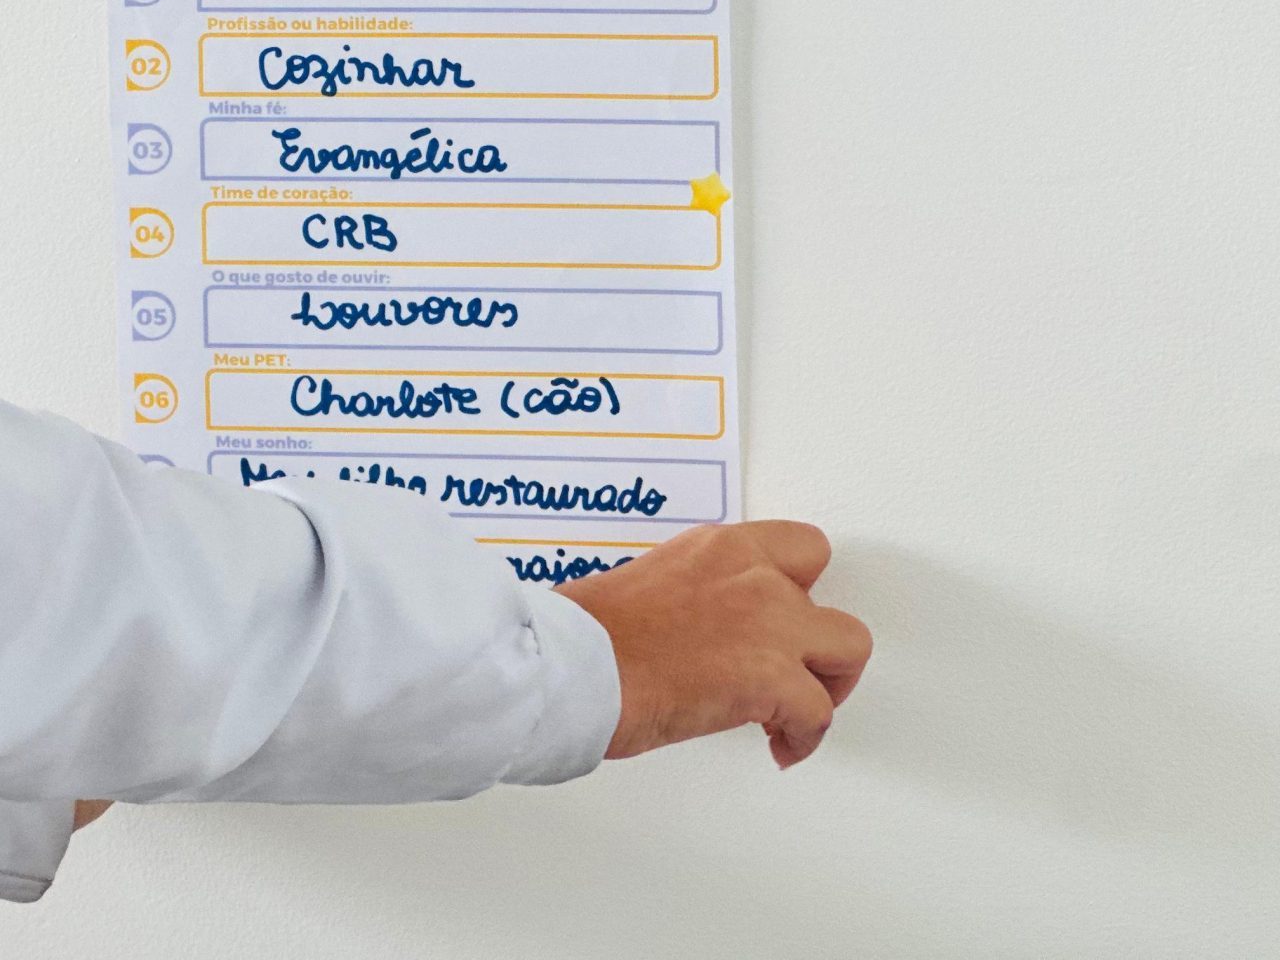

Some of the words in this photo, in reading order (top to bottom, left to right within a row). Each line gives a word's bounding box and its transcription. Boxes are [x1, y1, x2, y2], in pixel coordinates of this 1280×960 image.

[207, 17, 287, 30] Profissão
[291, 19, 313, 30] ou
[317, 17, 413, 30] habilidade:
[131, 57, 161, 75] 02
[259, 44, 475, 97] Cozinhar
[209, 102, 262, 114] Minha
[267, 101, 287, 115] fé:
[133, 141, 163, 159] 03
[271, 127, 508, 179] Evangélica
[210, 186, 253, 199] Time
[258, 186, 278, 199] de
[281, 186, 353, 203] coração:
[135, 225, 165, 243] 04
[302, 213, 397, 252] CRB
[212, 270, 224, 282] O
[229, 273, 260, 286] que
[265, 273, 313, 286] gosto
[317, 270, 337, 283] de
[342, 272, 391, 284] ouvir:
[136, 308, 167, 326] 05
[291, 291, 518, 330] Louvores
[214, 353, 250, 366] Meu
[254, 354, 291, 367] PET:
[140, 391, 169, 409] 06
[290, 375, 480, 419] Charlote
[501, 376, 620, 418] (cão)
[216, 436, 253, 448] Meu
[256, 436, 312, 449] sonho:
[440, 475, 667, 516] restaurado
